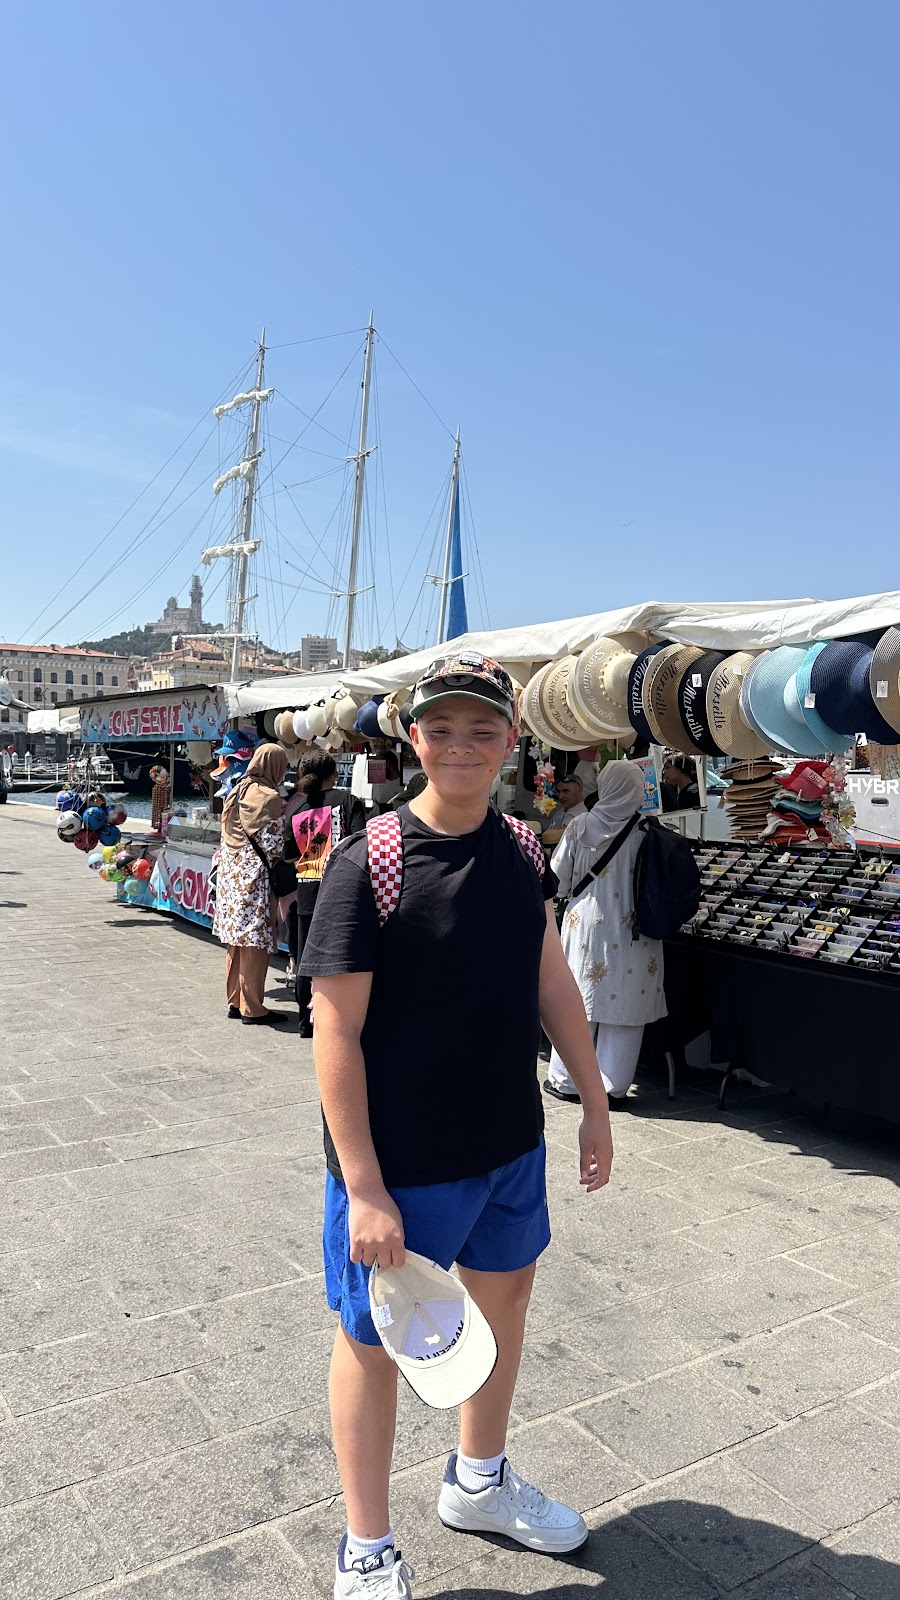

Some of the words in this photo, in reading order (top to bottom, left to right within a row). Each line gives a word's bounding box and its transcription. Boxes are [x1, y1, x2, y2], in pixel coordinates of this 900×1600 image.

[588, 695, 616, 720] Beach
[683, 678, 704, 741] Marseille
[713, 667, 730, 732] Marseille
[551, 710, 577, 735] Beach
[848, 777, 900, 797] HYBR
